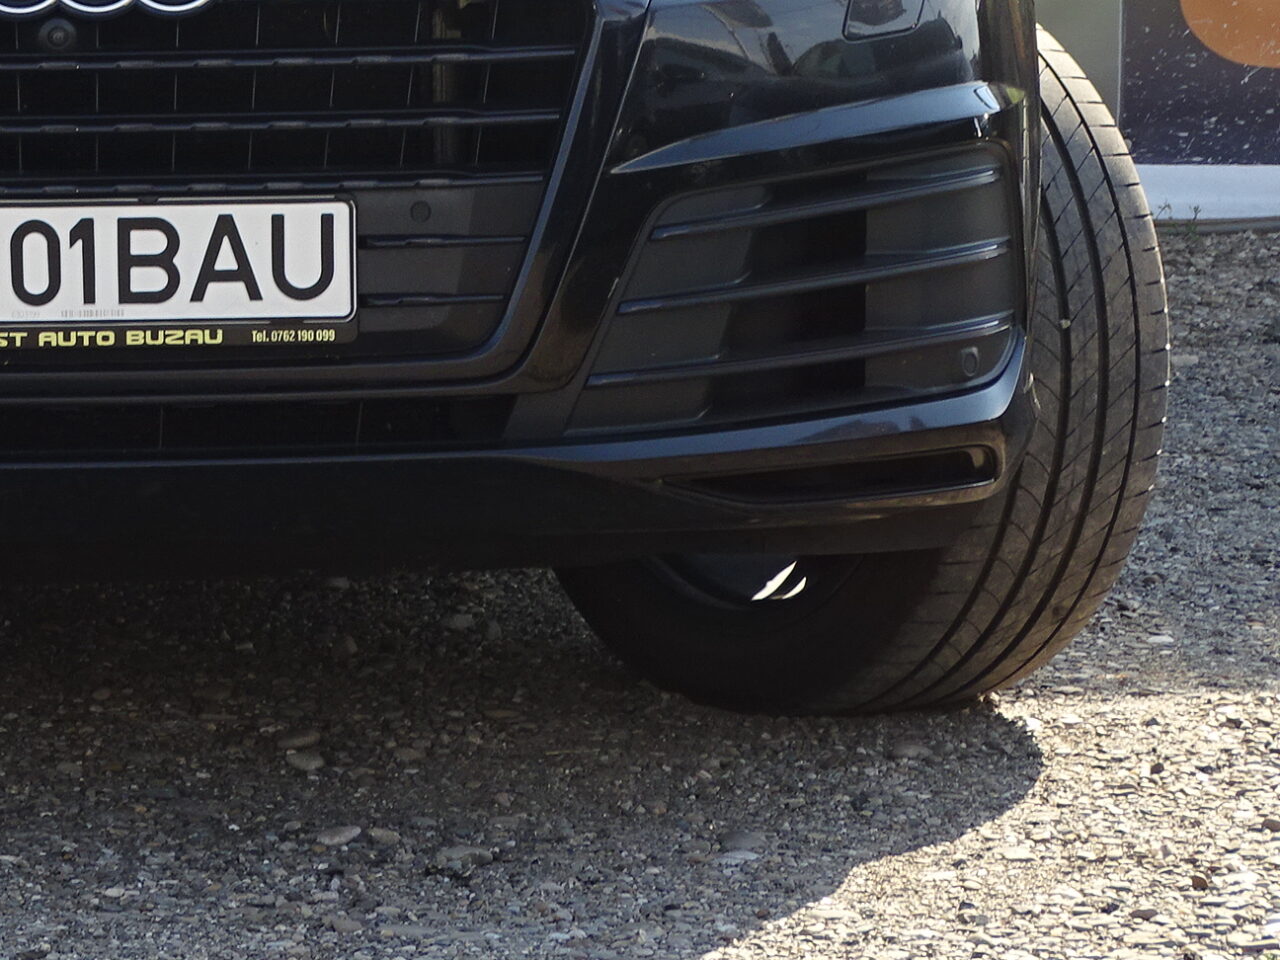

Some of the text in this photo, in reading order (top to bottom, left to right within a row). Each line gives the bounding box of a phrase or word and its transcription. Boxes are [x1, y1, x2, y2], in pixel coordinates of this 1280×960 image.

[38, 330, 115, 347] AUTO
[126, 329, 223, 346] BUZAU
[252, 329, 335, 343] Tel. 0762 190 099
